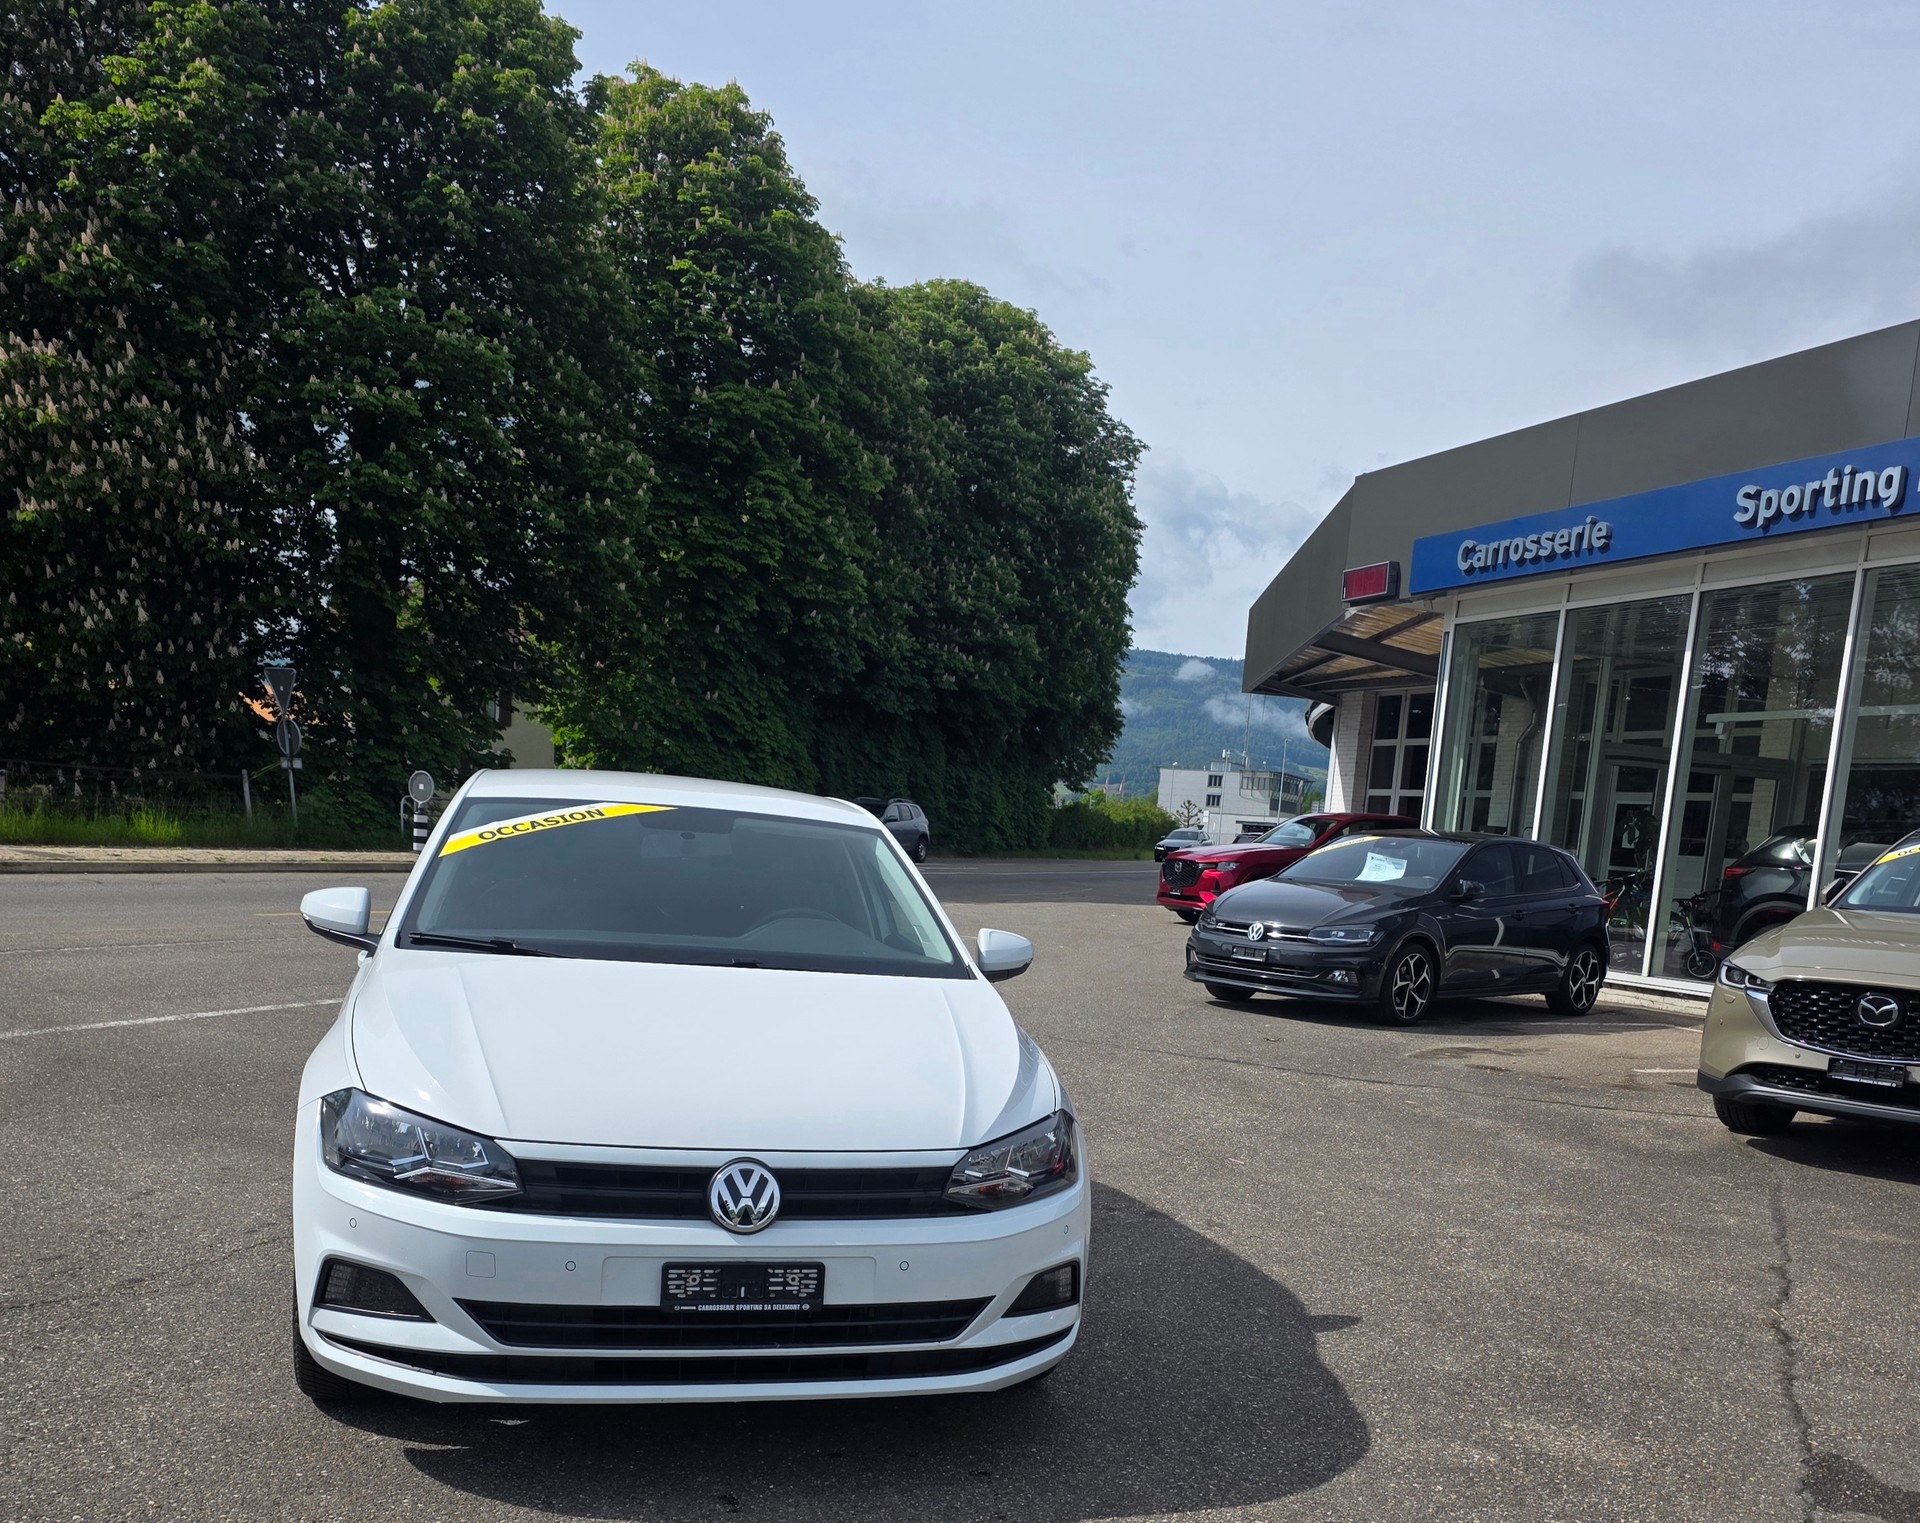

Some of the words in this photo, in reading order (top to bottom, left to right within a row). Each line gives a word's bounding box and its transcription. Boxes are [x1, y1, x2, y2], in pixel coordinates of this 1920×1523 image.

[1457, 516, 1611, 572] Carrosserie
[1733, 465, 1905, 528] Sporting
[478, 808, 606, 840] OCCASION
[711, 1161, 780, 1233] VW
[697, 1303, 735, 1311] CARROSSERIE
[735, 1303, 763, 1311] SPORTING
[764, 1303, 772, 1311] SA
